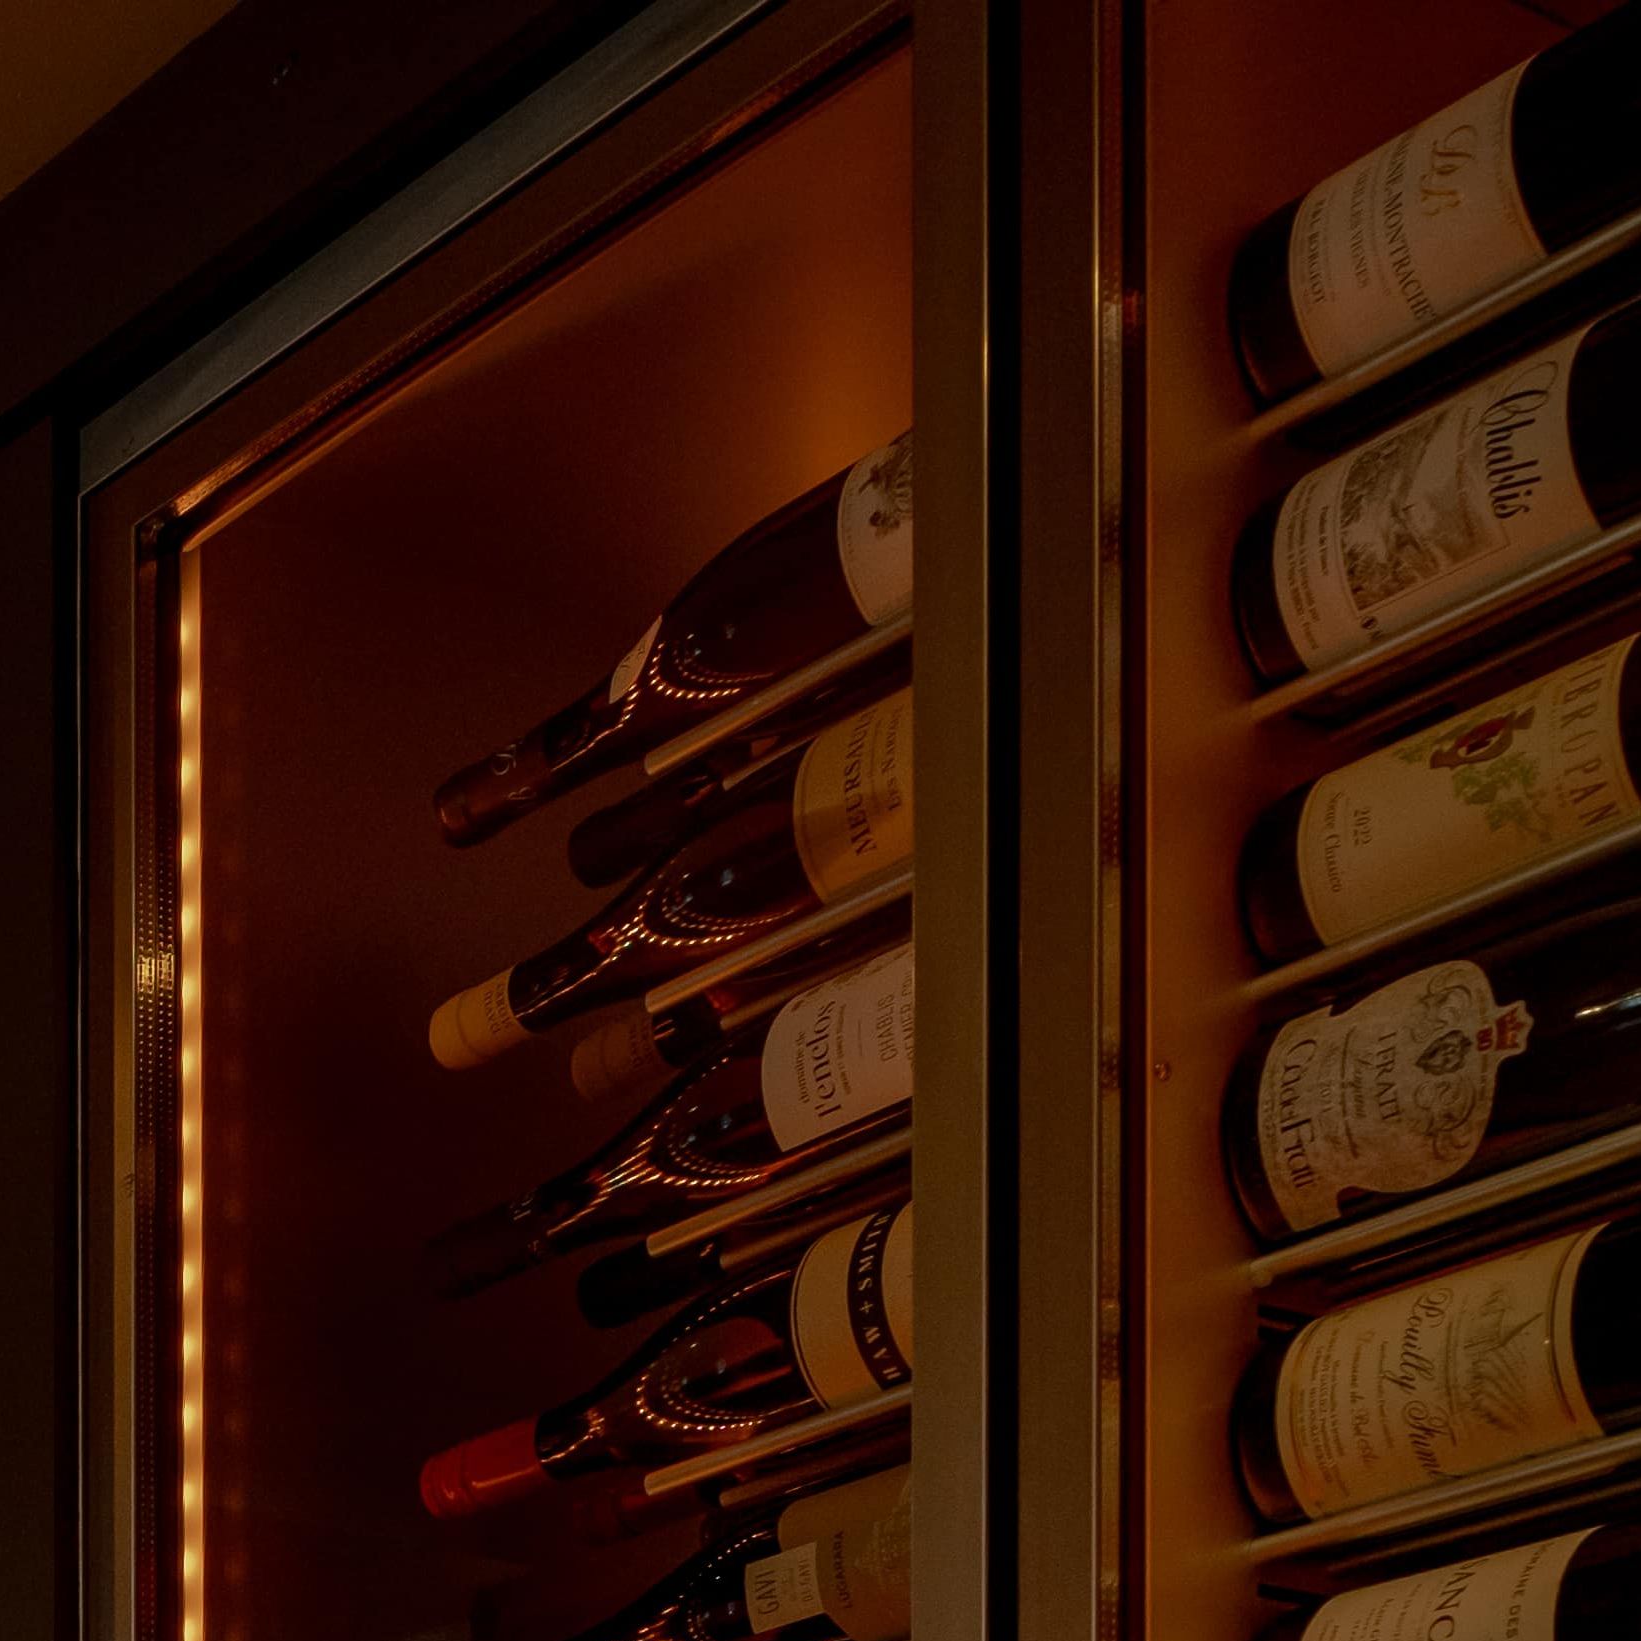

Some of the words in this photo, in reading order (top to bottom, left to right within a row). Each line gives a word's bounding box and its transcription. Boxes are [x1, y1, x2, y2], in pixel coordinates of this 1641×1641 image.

[1471, 358, 1562, 524] Chablis
[1352, 805, 1371, 849] 2022
[1323, 832, 1344, 893] Classico
[877, 993, 897, 1062] CHABLIS
[1473, 1027, 1496, 1053] 80
[797, 1049, 810, 1103] domaine
[803, 1001, 841, 1119] l'enclos
[857, 1213, 890, 1291] SMITH
[1388, 1286, 1451, 1390] Pouilly
[753, 1568, 781, 1616] GAVI
[1506, 1605, 1521, 1637] DES
